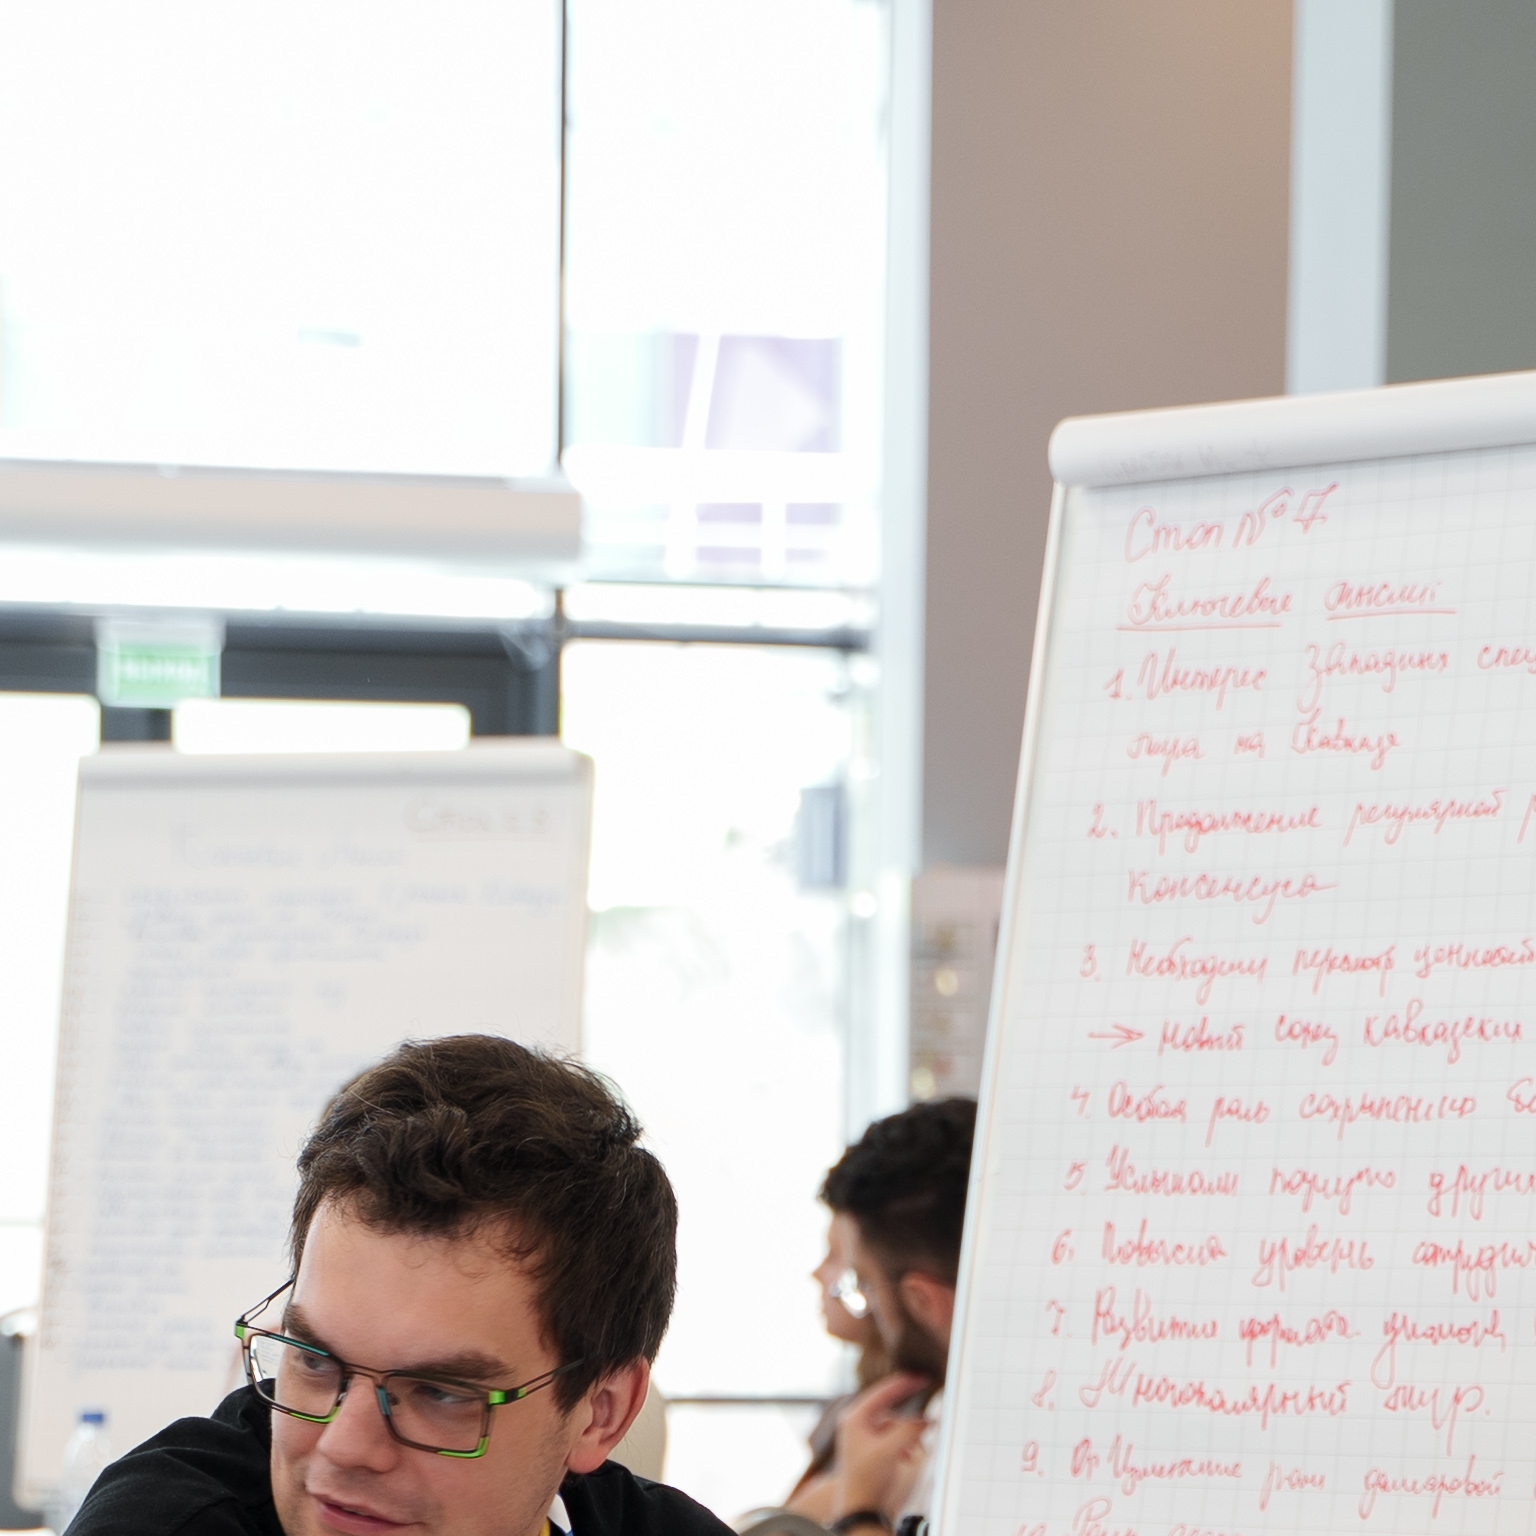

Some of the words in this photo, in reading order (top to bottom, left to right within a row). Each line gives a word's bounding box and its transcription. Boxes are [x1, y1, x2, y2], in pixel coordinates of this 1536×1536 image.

[1127, 573, 1292, 625] Ключевые
[1103, 667, 1132, 700] 1.
[1136, 647, 1268, 710] Интерес
[1234, 731, 1265, 758] на
[1087, 803, 1118, 838] 2.
[1136, 799, 1322, 856] Продолжение
[1343, 788, 1509, 846] регулярной
[1079, 943, 1101, 981] 3.
[1069, 1085, 1091, 1119] 4.
[1107, 1080, 1188, 1123] Особая
[1063, 1161, 1088, 1197] 5.
[1428, 1163, 1536, 1221] других
[1251, 1222, 1374, 1293] уровень
[1045, 1299, 1073, 1338] 7.
[1092, 1285, 1220, 1351] Развитие
[1030, 1368, 1058, 1412] 8.
[1078, 1355, 1353, 1431] Многополярный
[1021, 1440, 1044, 1478] 9.
